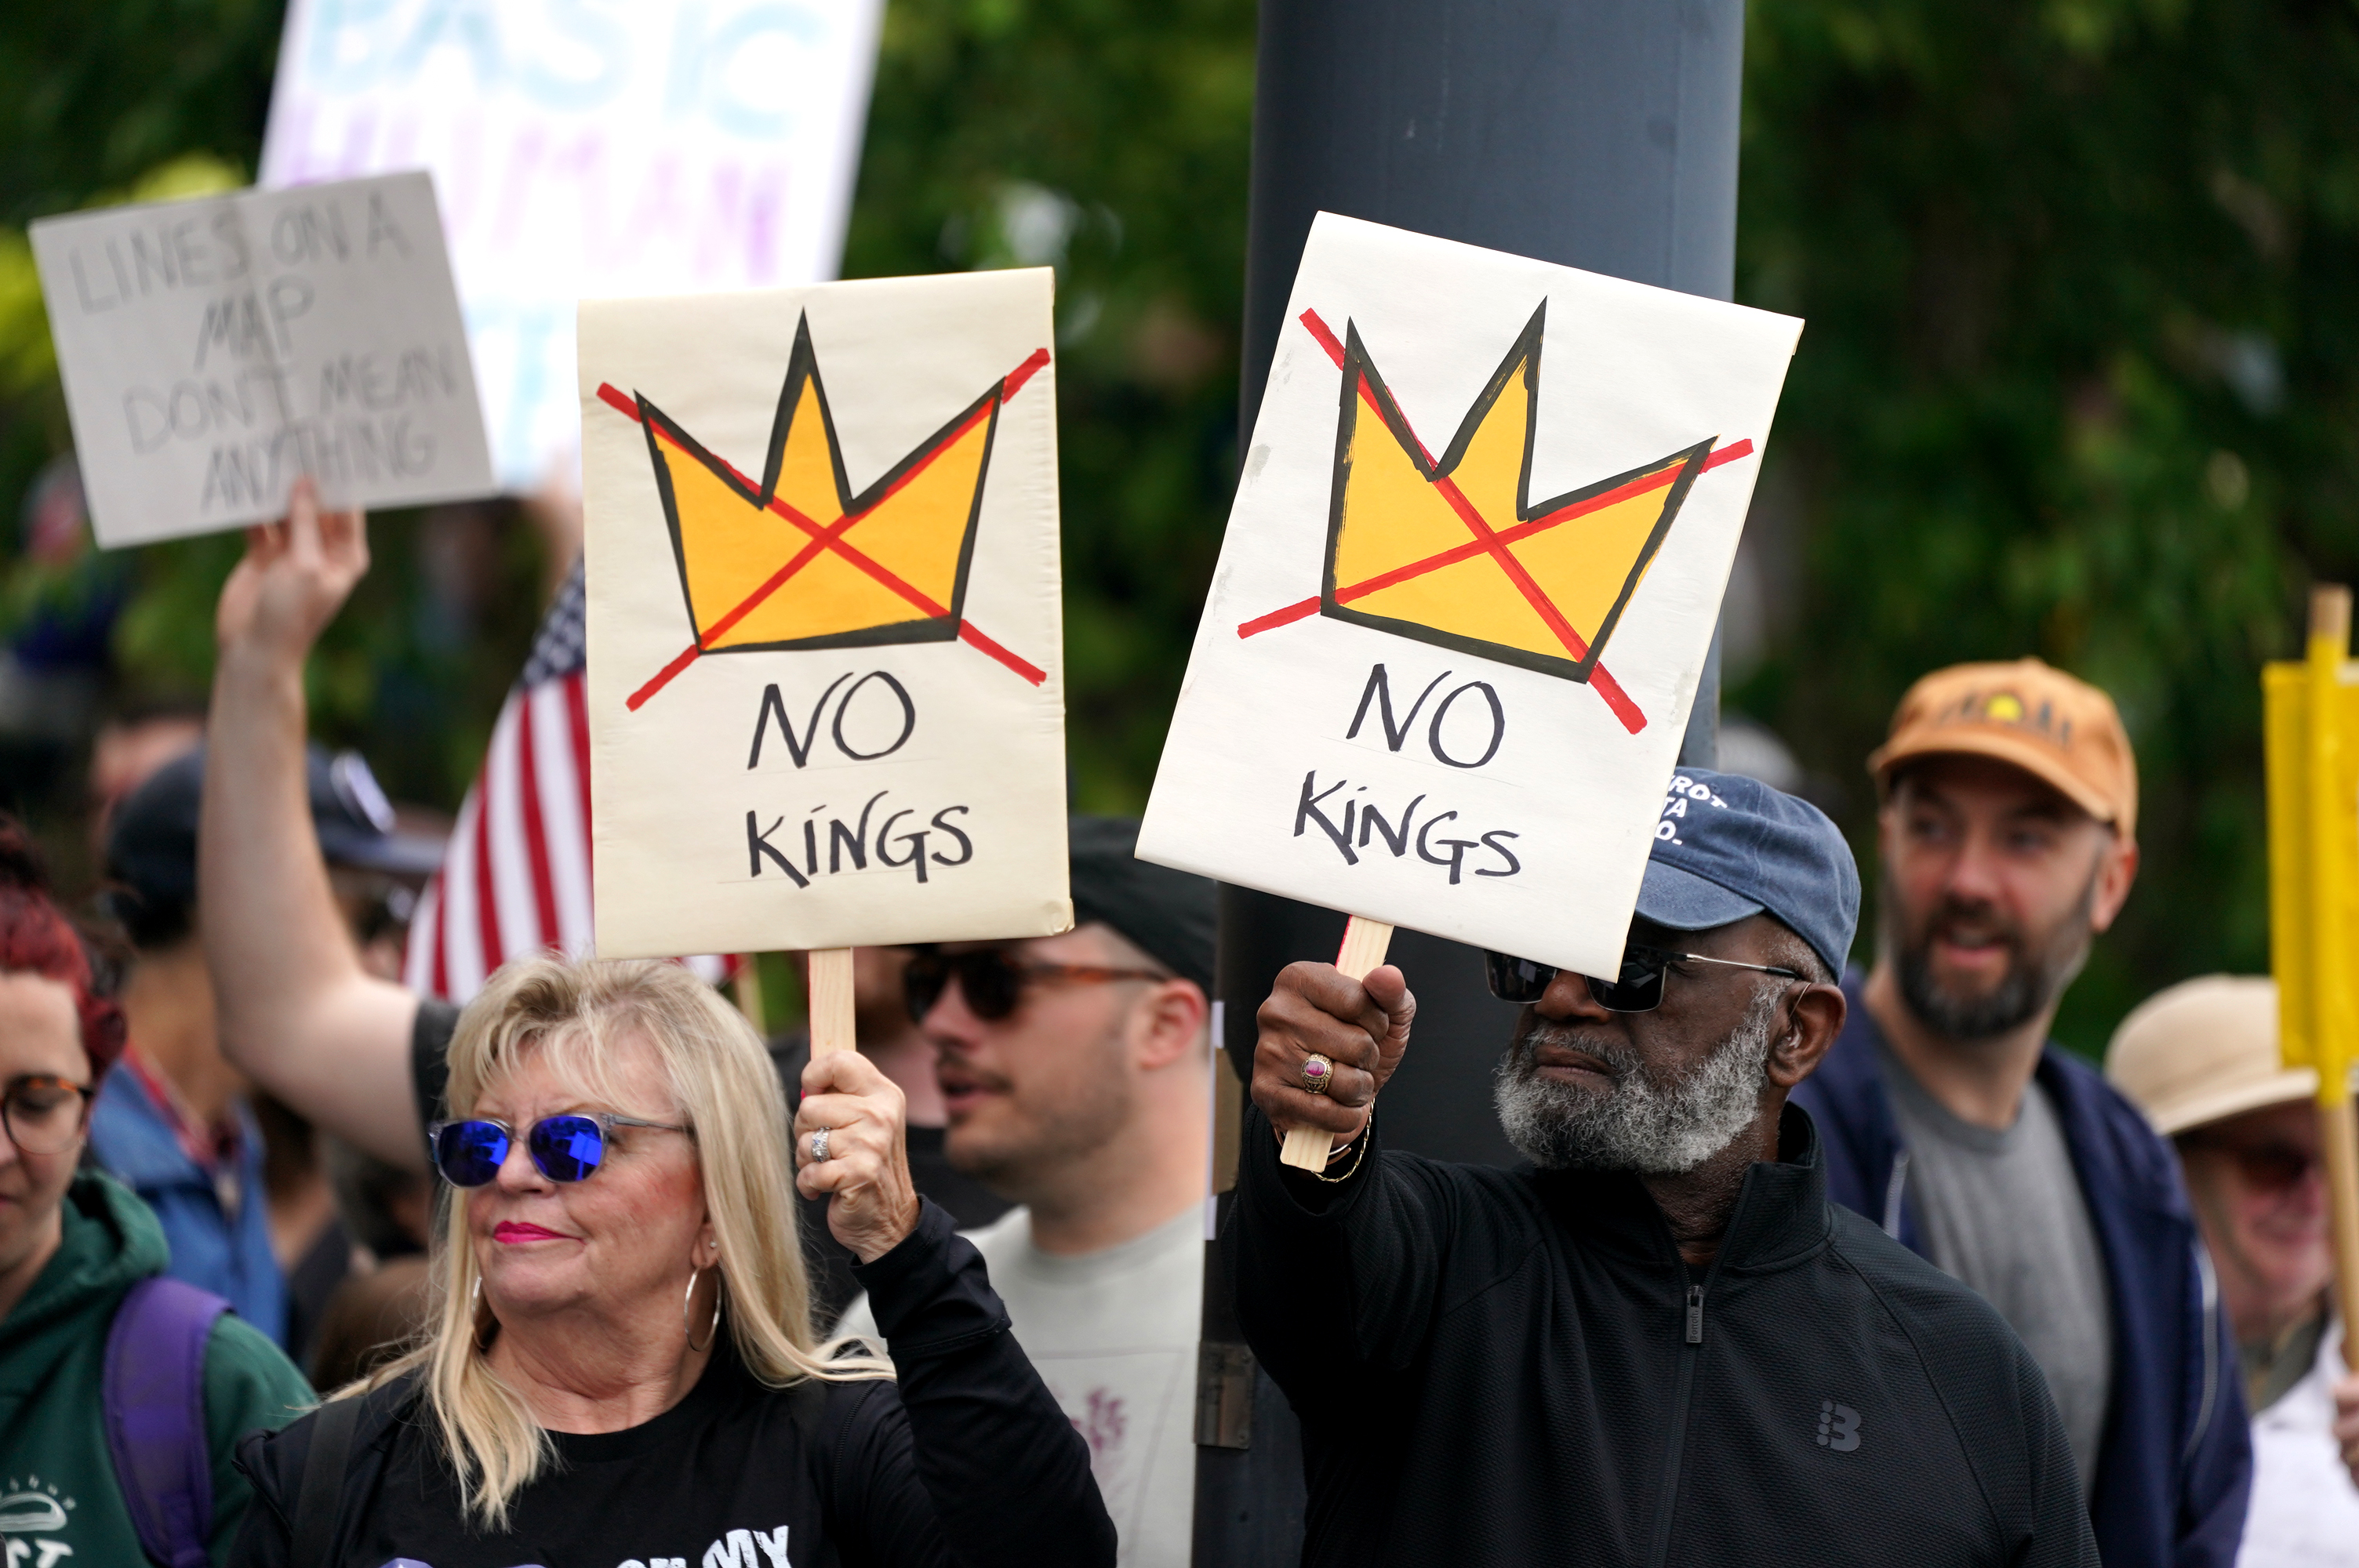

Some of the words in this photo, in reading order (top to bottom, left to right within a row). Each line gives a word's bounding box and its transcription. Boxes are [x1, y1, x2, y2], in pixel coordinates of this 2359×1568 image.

[304, 0, 833, 141] BASIC
[68, 202, 253, 314] LINES
[271, 198, 351, 266] ON
[366, 190, 415, 260] A
[193, 274, 315, 372] MAP
[319, 342, 457, 414] MEAN
[199, 413, 439, 514] ANYTHING
[747, 670, 916, 771] NO
[1346, 662, 1506, 769] NO
